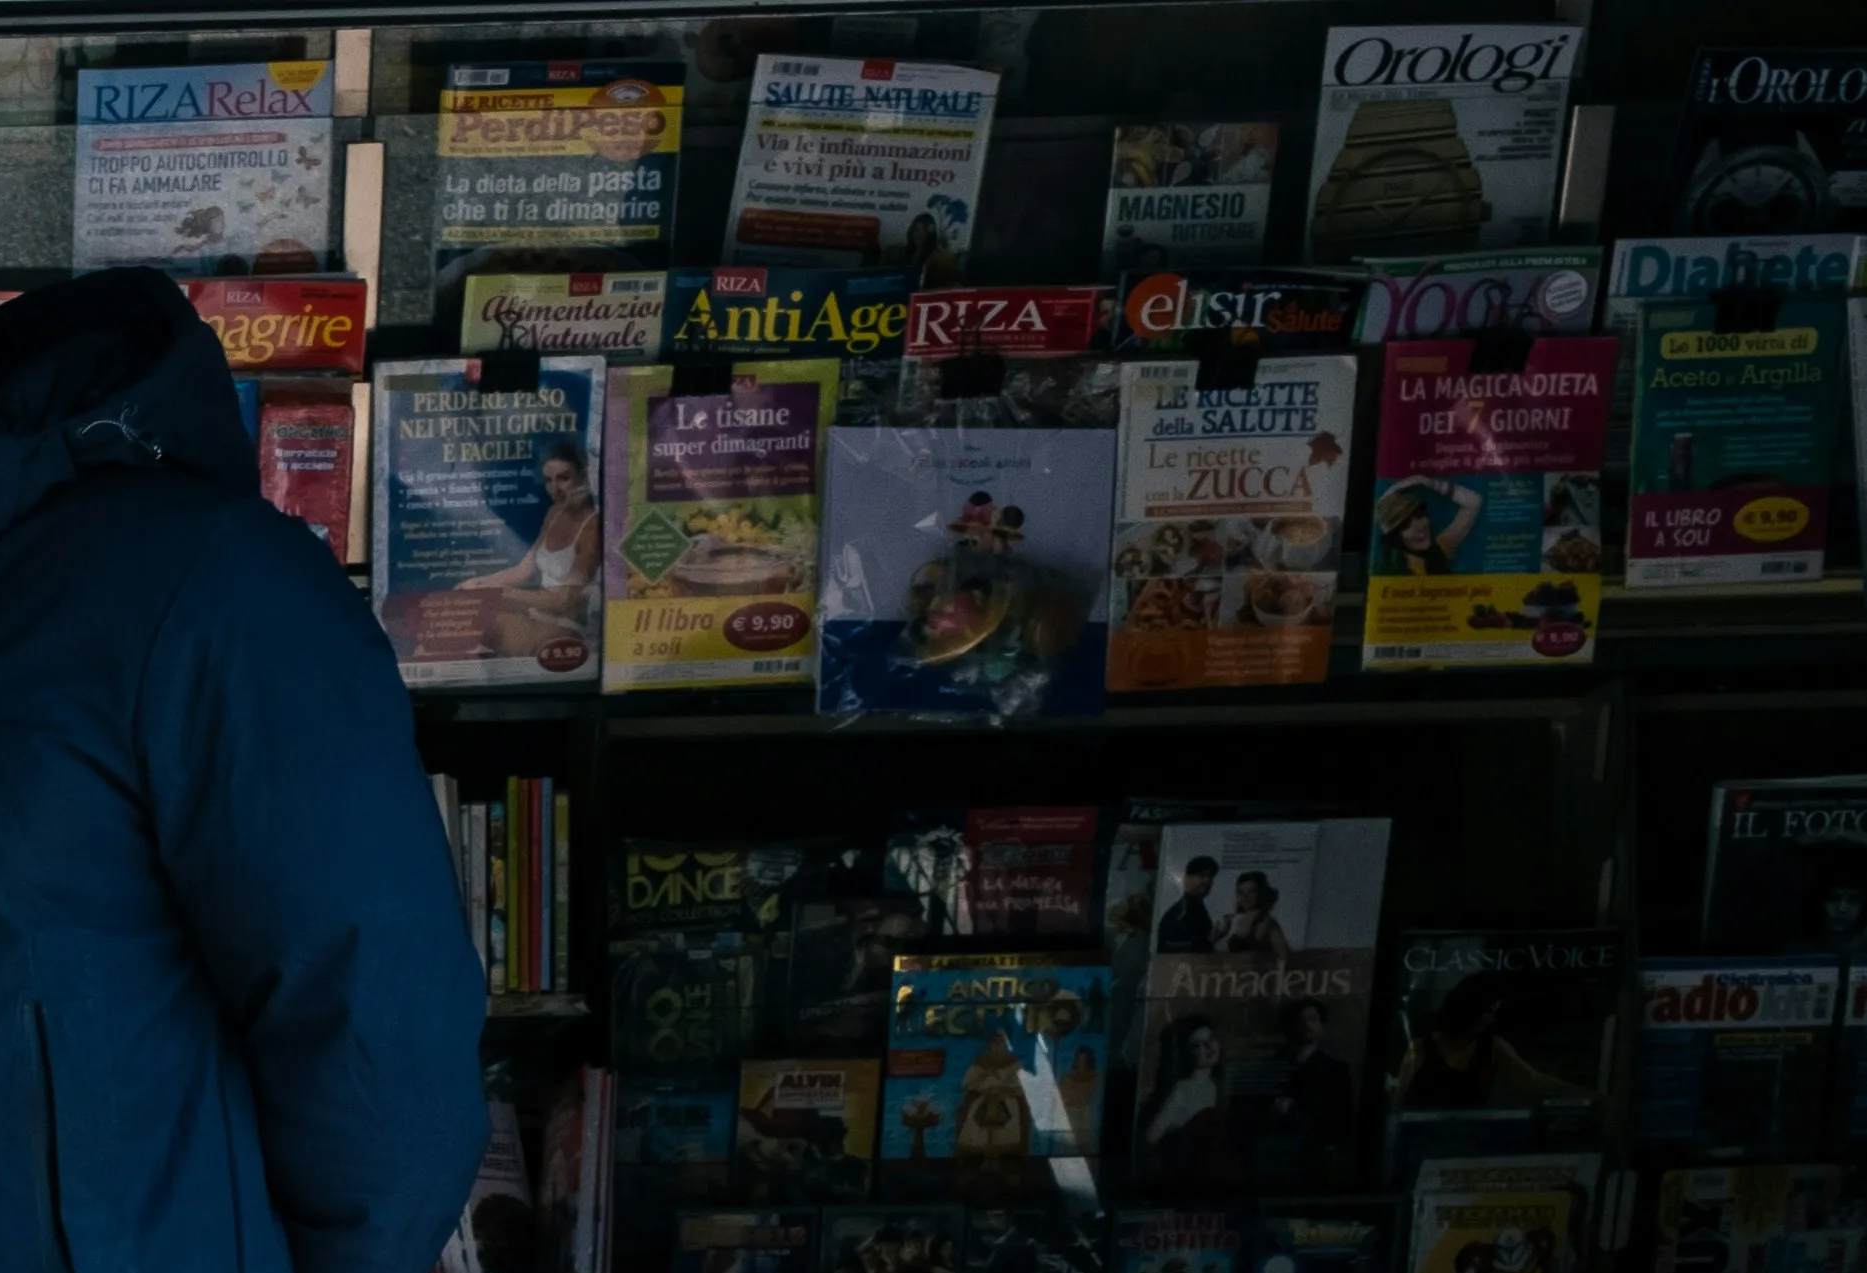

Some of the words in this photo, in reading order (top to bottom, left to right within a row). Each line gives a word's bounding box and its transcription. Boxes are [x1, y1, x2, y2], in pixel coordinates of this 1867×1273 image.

[1334, 33, 1569, 93] Orologi
[89, 153, 152, 175] TROPPO
[155, 148, 289, 173] AUTOCONTROLLO
[757, 133, 787, 155] Via
[791, 136, 813, 156] le
[818, 136, 972, 162] infiammazioni
[445, 175, 470, 196] La
[475, 172, 530, 194] dieta
[588, 169, 661, 194] pasta
[443, 199, 488, 222] che
[493, 199, 511, 221] ti
[546, 196, 660, 224] dimagrire
[1118, 191, 1245, 222] MAGNESIO
[224, 288, 261, 305] RIZA
[715, 274, 762, 293] RIZA
[1141, 276, 1283, 333] elisir
[674, 287, 907, 354] AntiAge
[913, 299, 1048, 348] RIZA
[1268, 307, 1343, 335] Salute
[1400, 379, 1425, 399] LA
[1433, 375, 1523, 399] MAGICA
[1531, 372, 1599, 396] DIETA
[399, 418, 434, 439] NEI
[440, 416, 502, 437] PUNTI
[507, 412, 578, 434] GIUSTI
[676, 404, 707, 429] Le
[714, 403, 790, 428] tisane
[1152, 415, 1194, 437] della
[1201, 407, 1318, 434] SALUTE
[1419, 412, 1455, 435] DEI
[1489, 406, 1572, 432] GIORNI
[711, 429, 811, 456] dimagranti
[1187, 464, 1314, 501] ZUCCA
[1665, 507, 1722, 527] LIBRO
[1528, 942, 1616, 971] VOICE
[1170, 963, 1352, 999] Amadeus
[779, 1072, 843, 1091] ALVIN
